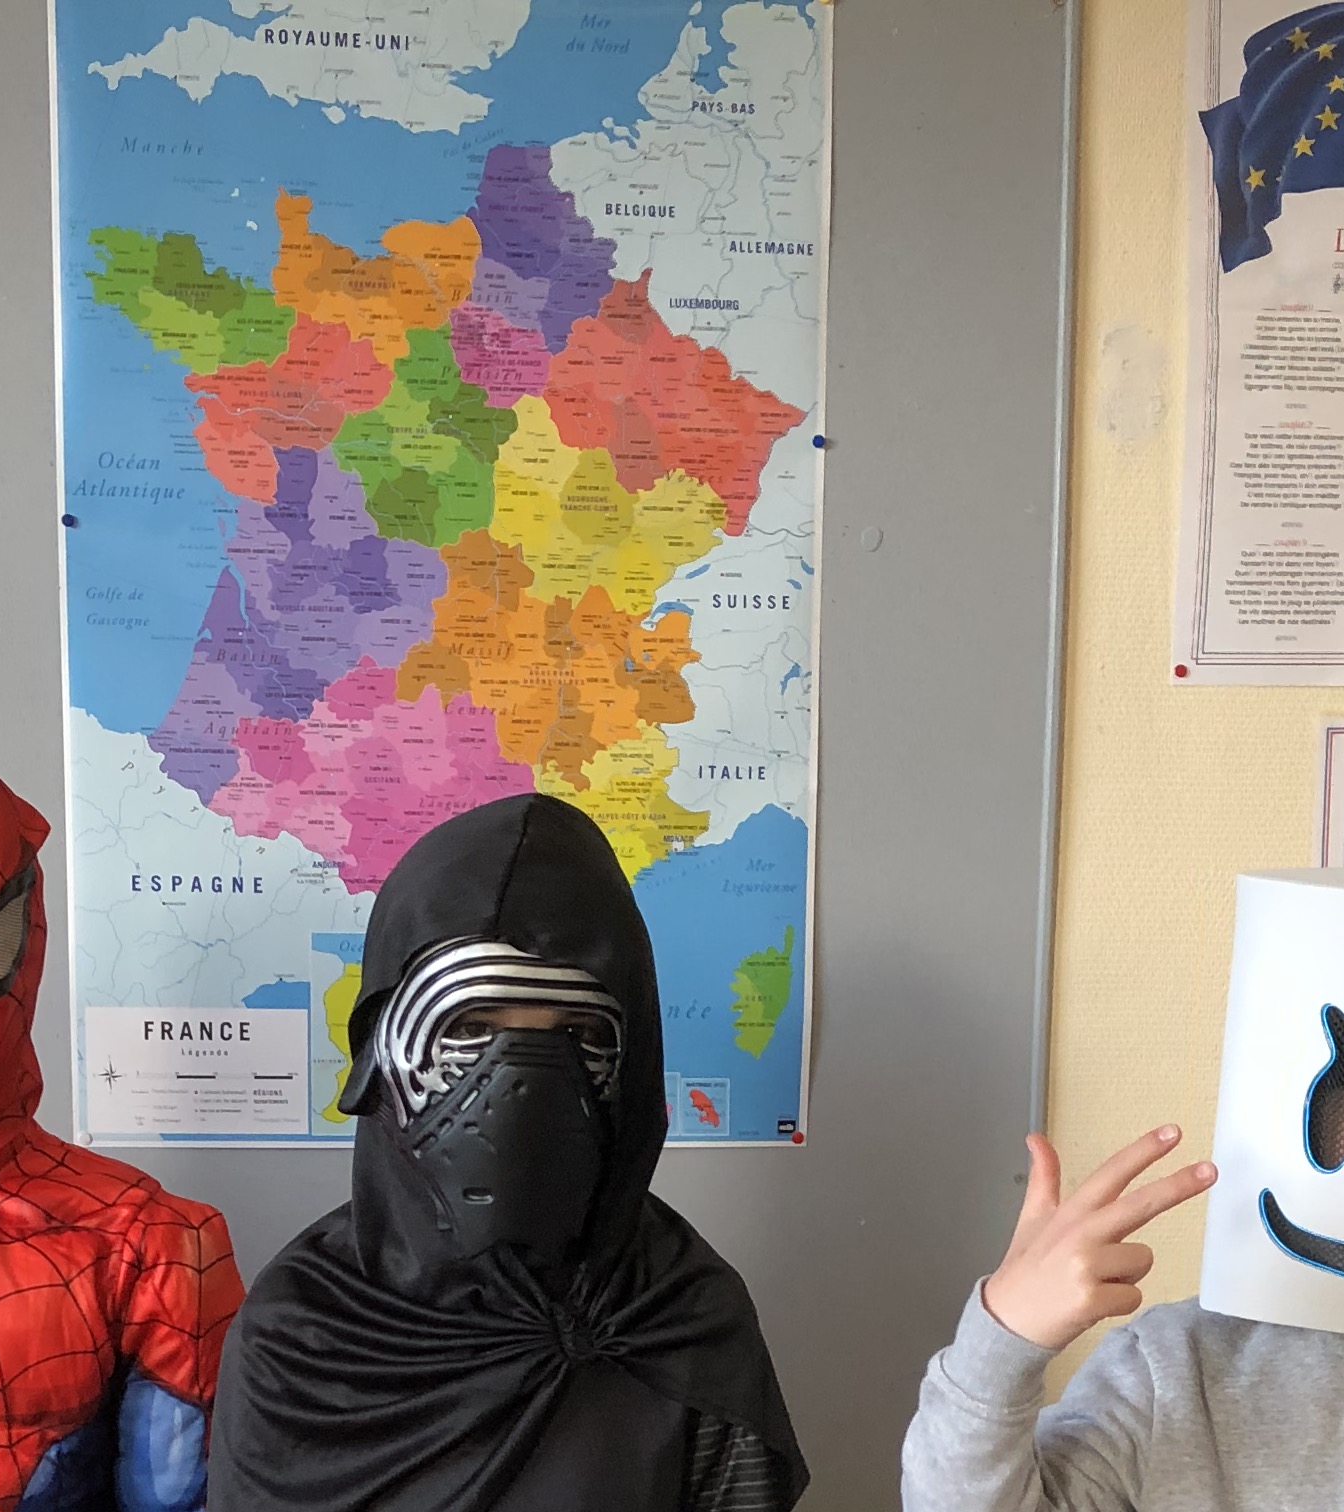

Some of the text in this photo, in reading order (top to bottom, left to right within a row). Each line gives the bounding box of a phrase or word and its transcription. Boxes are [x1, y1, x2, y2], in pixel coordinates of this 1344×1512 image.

[264, 28, 410, 51] ROYAUME-UNI
[591, 38, 632, 55] Nord
[120, 136, 206, 157] Manche
[604, 202, 677, 219] BELGIQUE
[728, 239, 815, 257] ALLEMAGNE
[668, 297, 741, 312] LUXEMBOURG
[97, 450, 162, 471] Océan
[72, 478, 186, 504] Atlantique
[84, 586, 145, 604] Golfe de
[712, 593, 791, 611] SUISSE
[85, 612, 151, 630] Gascogne
[698, 764, 767, 781] ITALIE
[131, 874, 264, 895] ESPAGNE
[143, 1020, 251, 1041] FRANCE
